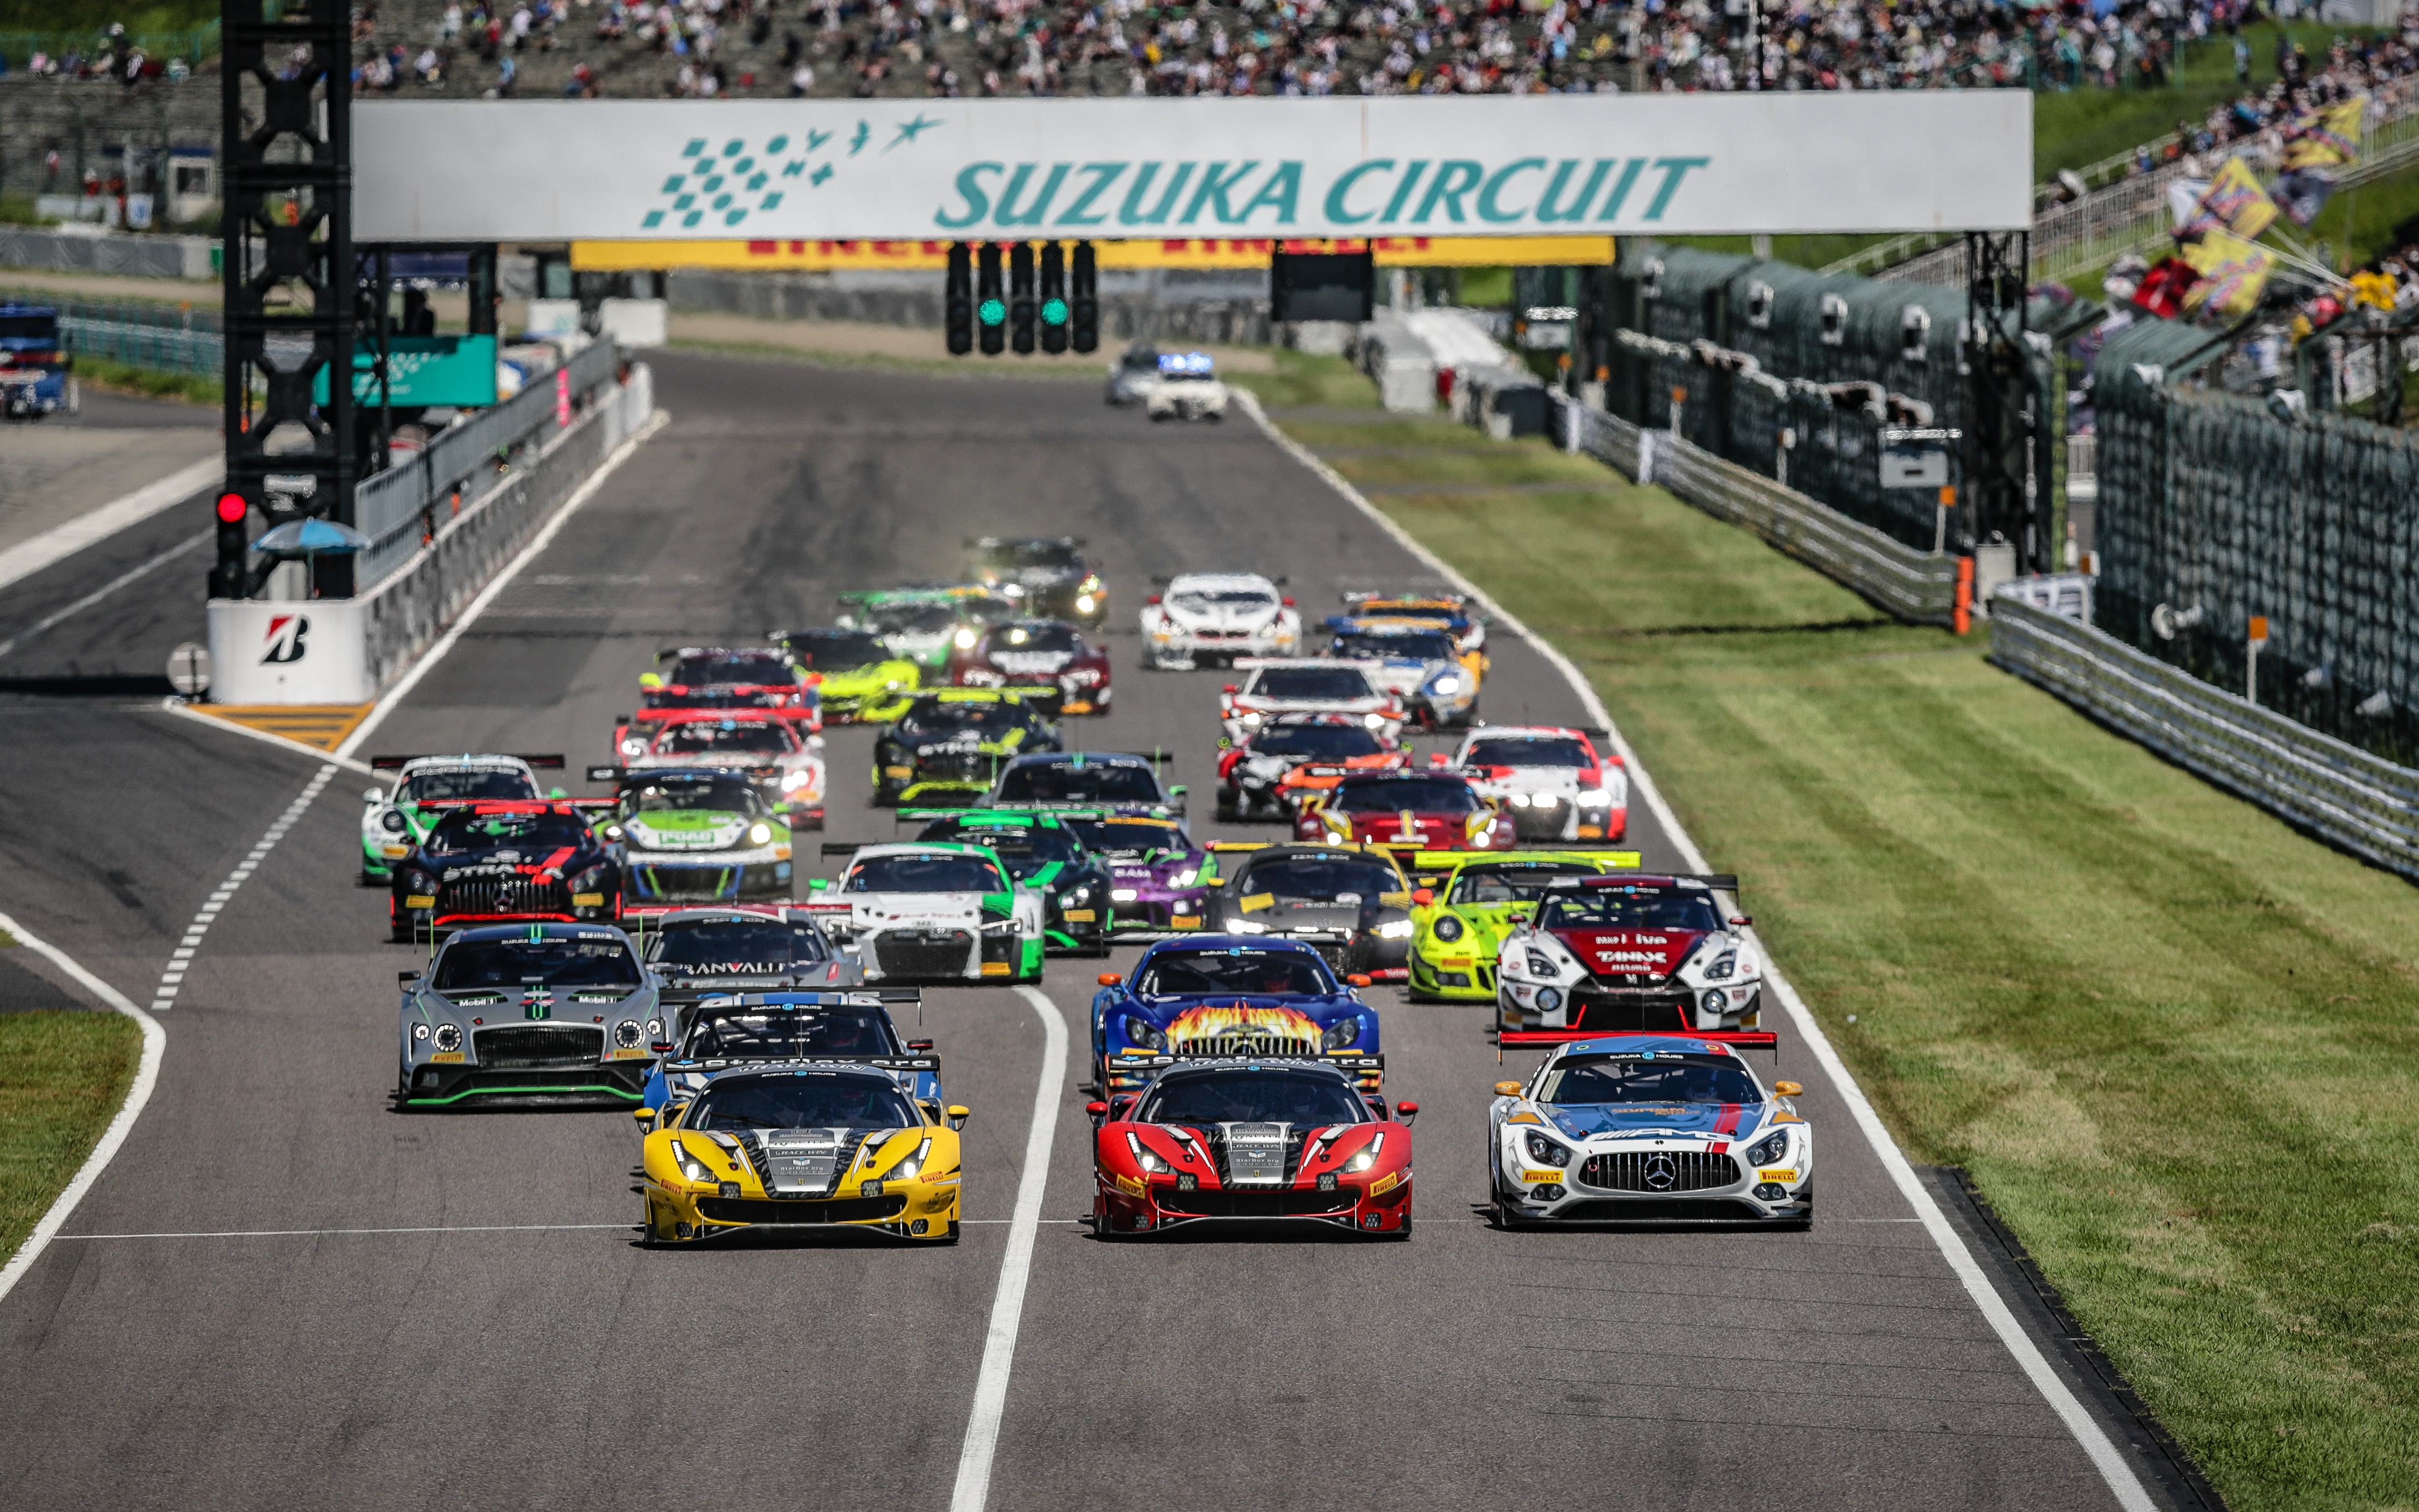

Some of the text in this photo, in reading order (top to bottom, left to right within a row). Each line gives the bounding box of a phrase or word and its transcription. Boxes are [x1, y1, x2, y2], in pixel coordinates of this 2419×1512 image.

[933, 157, 1713, 228] SUZUKA CIRCUIT
[578, 996, 606, 1004] Mobil
[1631, 1128, 1735, 1142] AMG
[920, 1171, 943, 1184] PIRELLI
[1525, 1172, 1560, 1181] PIRELLI
[1762, 1172, 1794, 1180] PIRELLI
[1373, 1175, 1395, 1194] PIRELLI
